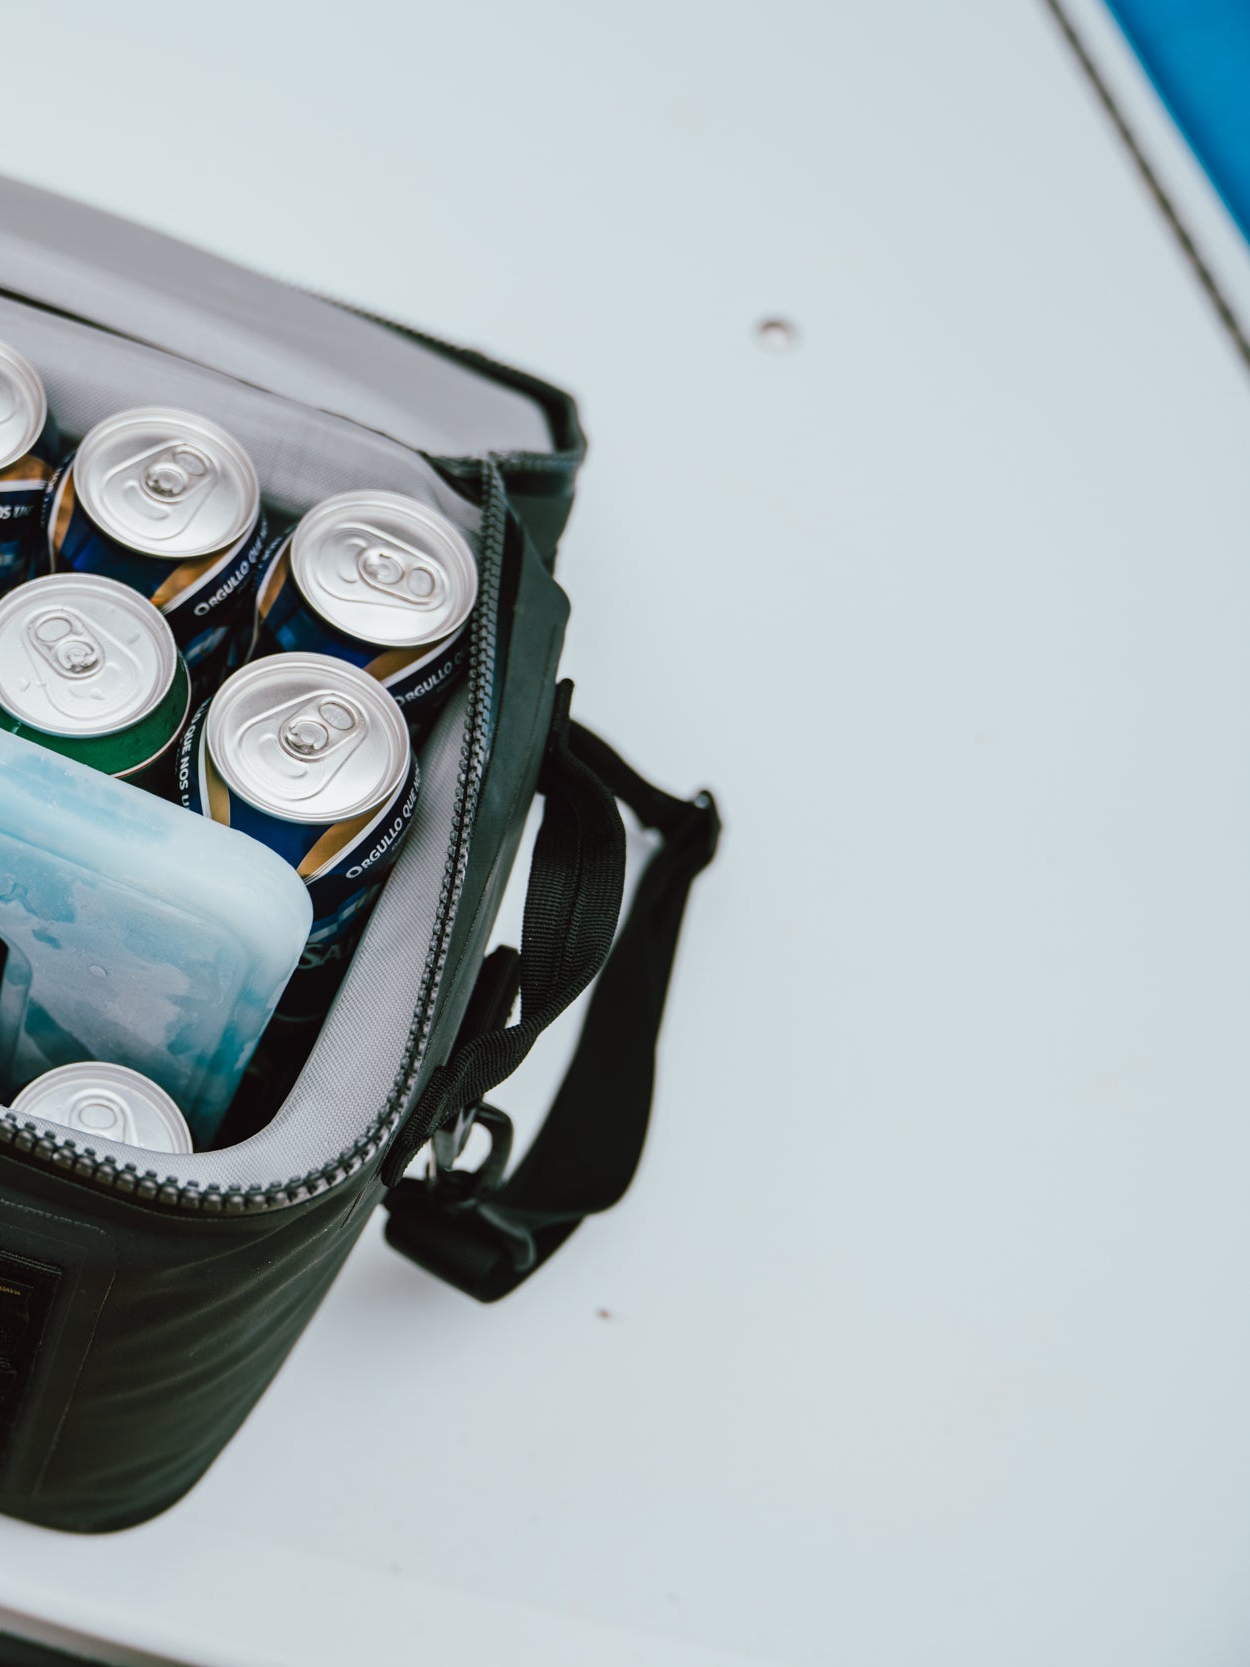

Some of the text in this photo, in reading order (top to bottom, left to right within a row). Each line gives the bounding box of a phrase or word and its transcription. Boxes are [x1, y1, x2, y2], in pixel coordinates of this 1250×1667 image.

[194, 560, 250, 616] ORGULLO
[182, 724, 197, 756] QUE
[179, 755, 190, 790] NOS
[345, 817, 403, 879] ORGULLO
[402, 787, 417, 819] QUE
